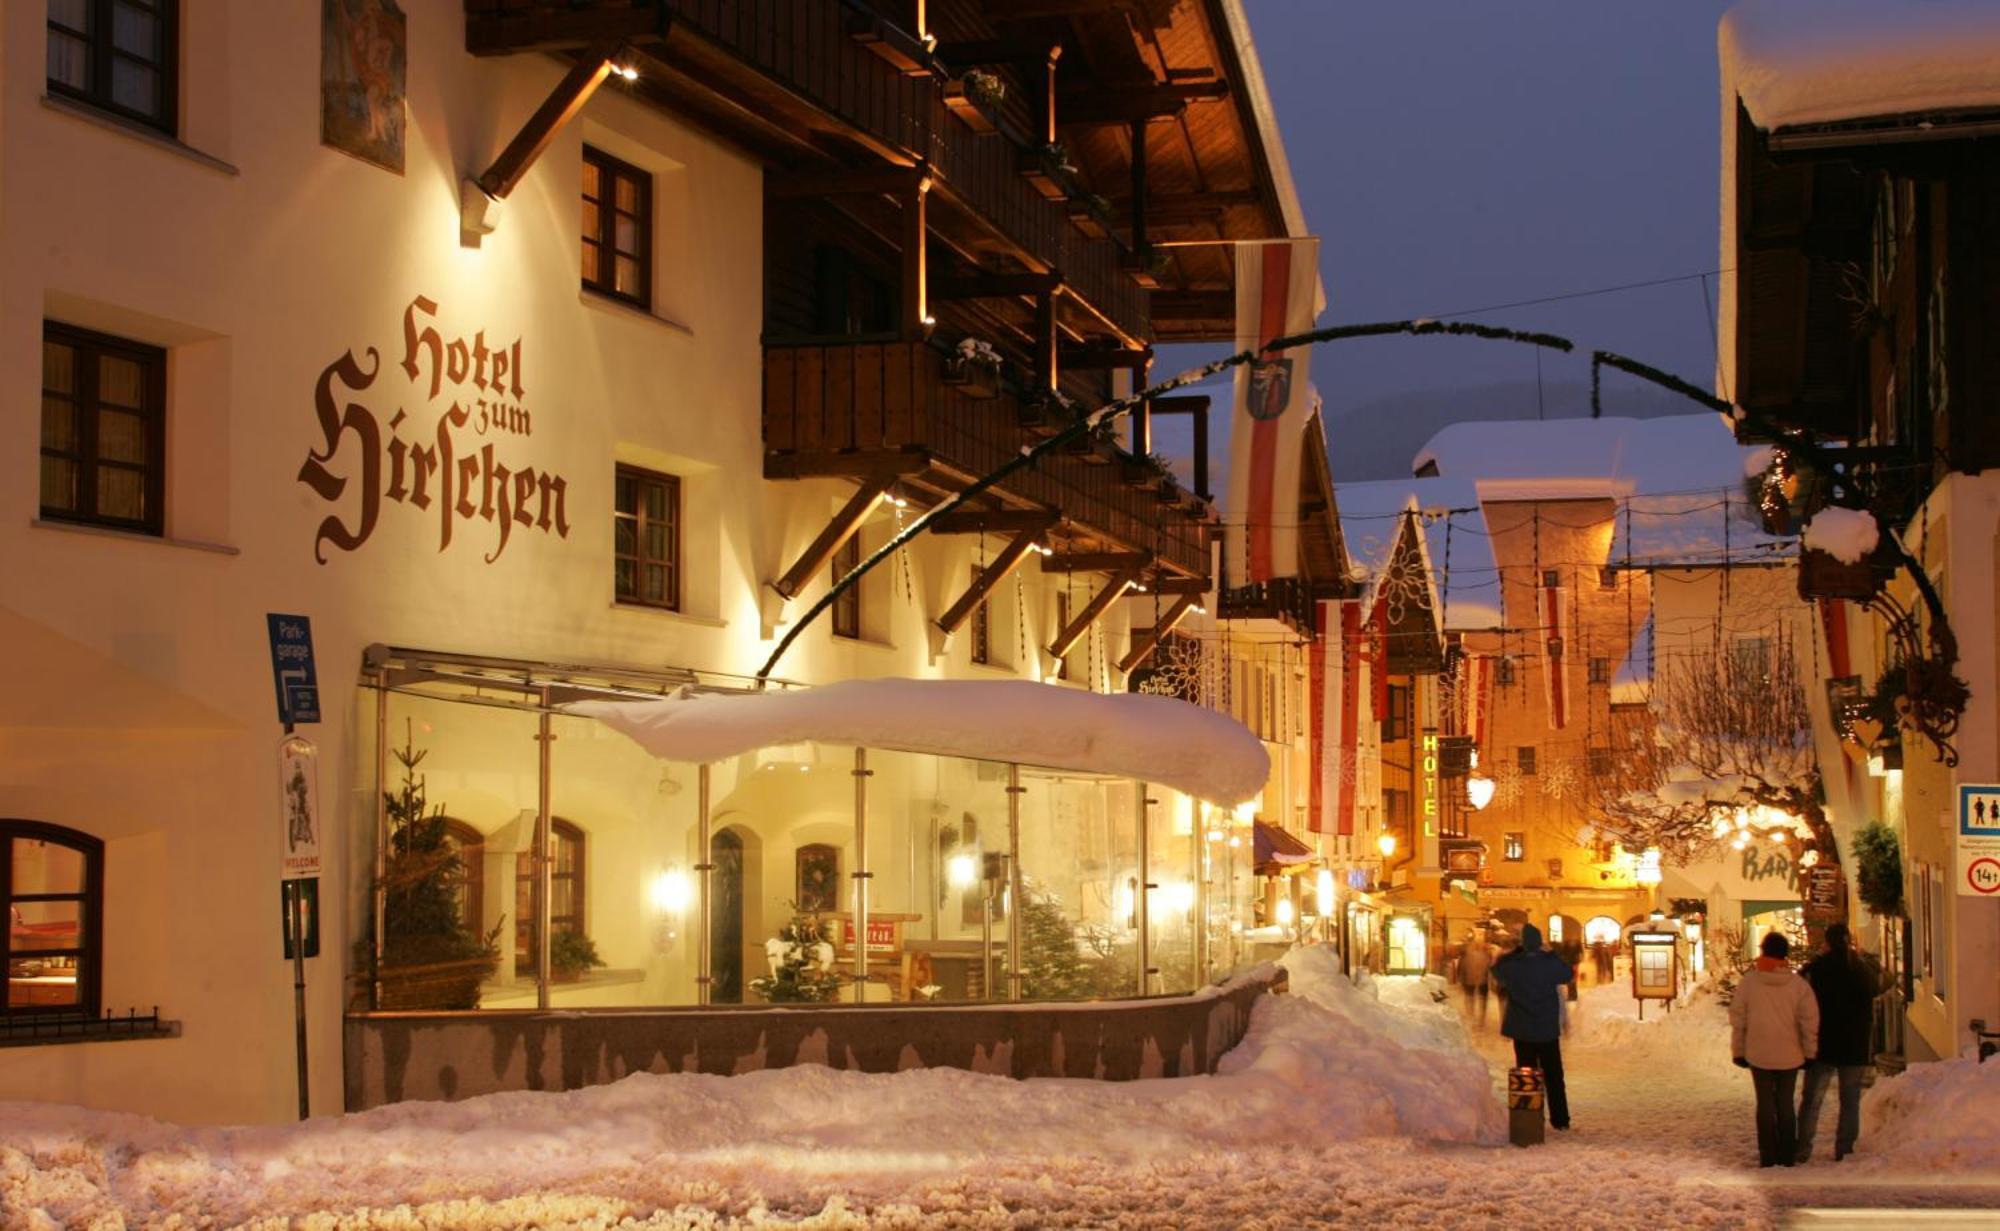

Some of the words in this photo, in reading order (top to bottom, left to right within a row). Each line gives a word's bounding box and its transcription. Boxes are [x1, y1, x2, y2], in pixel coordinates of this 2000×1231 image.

[400, 294, 525, 401] Hotel
[475, 398, 532, 437] zum
[277, 643, 309, 661] garage
[1423, 735, 1437, 837] HOTEL
[285, 855, 320, 868] WELCOME
